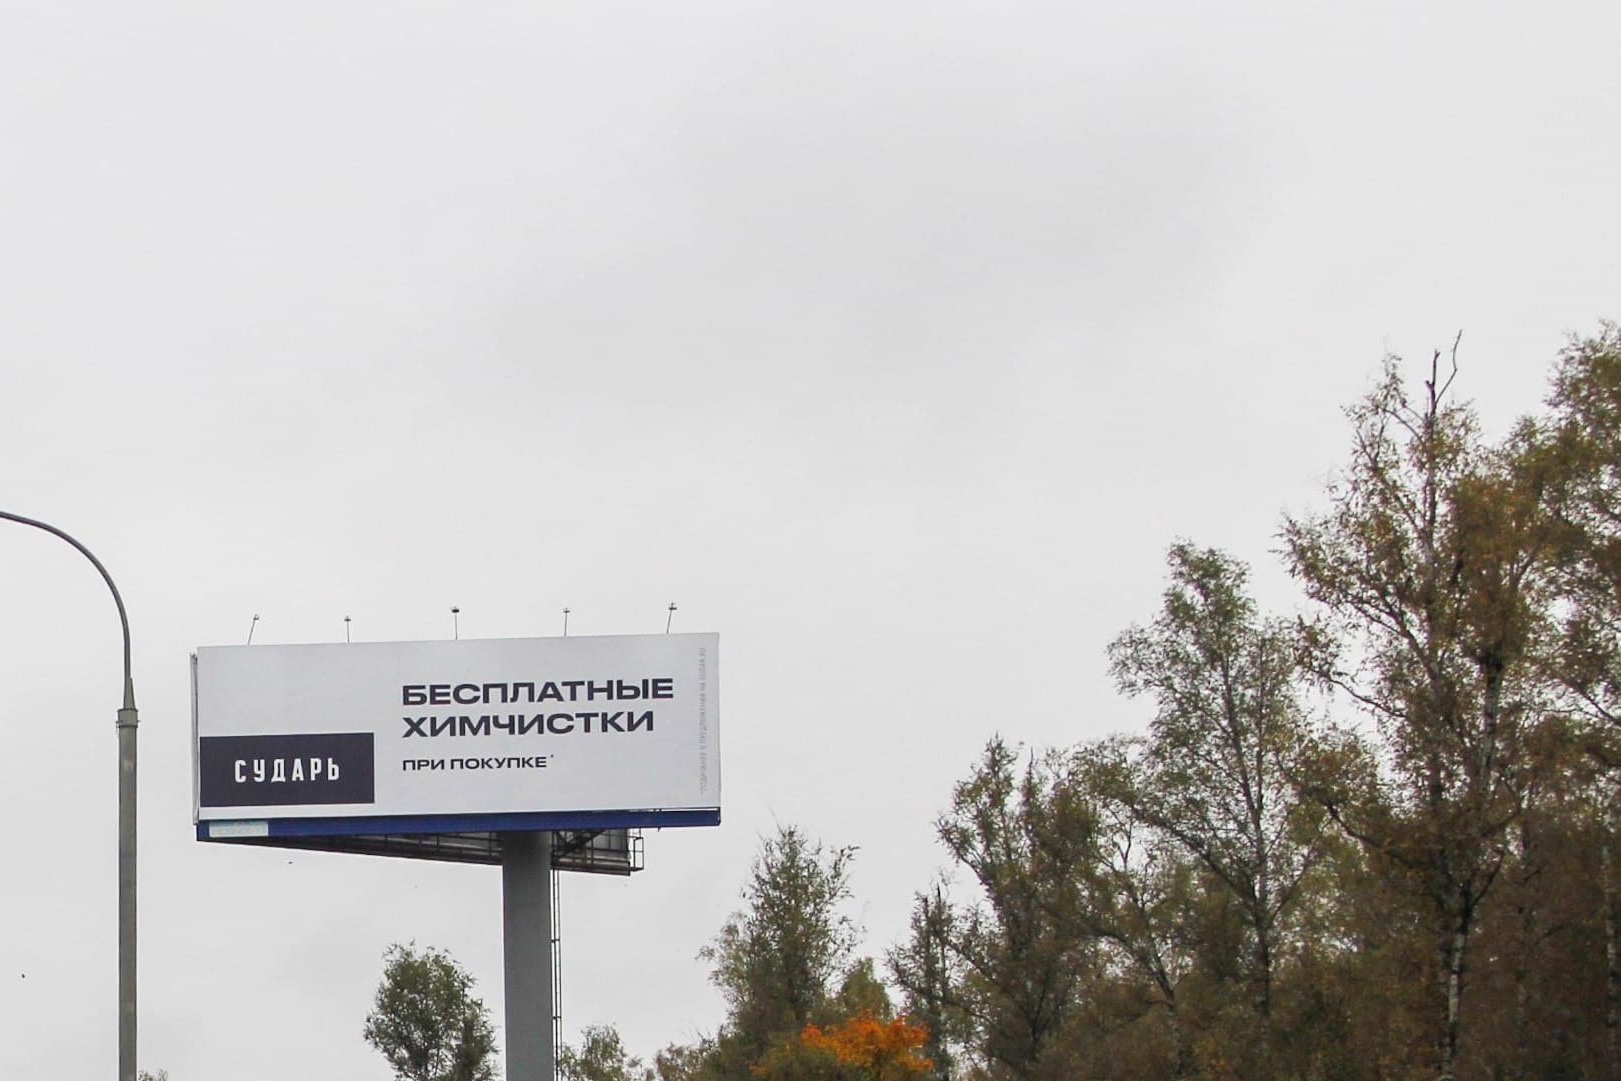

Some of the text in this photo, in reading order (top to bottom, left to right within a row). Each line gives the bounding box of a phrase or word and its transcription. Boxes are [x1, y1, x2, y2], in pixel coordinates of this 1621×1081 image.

[401, 678, 674, 706] БЕСПЛАТНЫЕ
[401, 710, 655, 738] ХИМЧИСТКИ
[234, 757, 340, 783] СУДАРЬ
[402, 759, 445, 771] ПРИ
